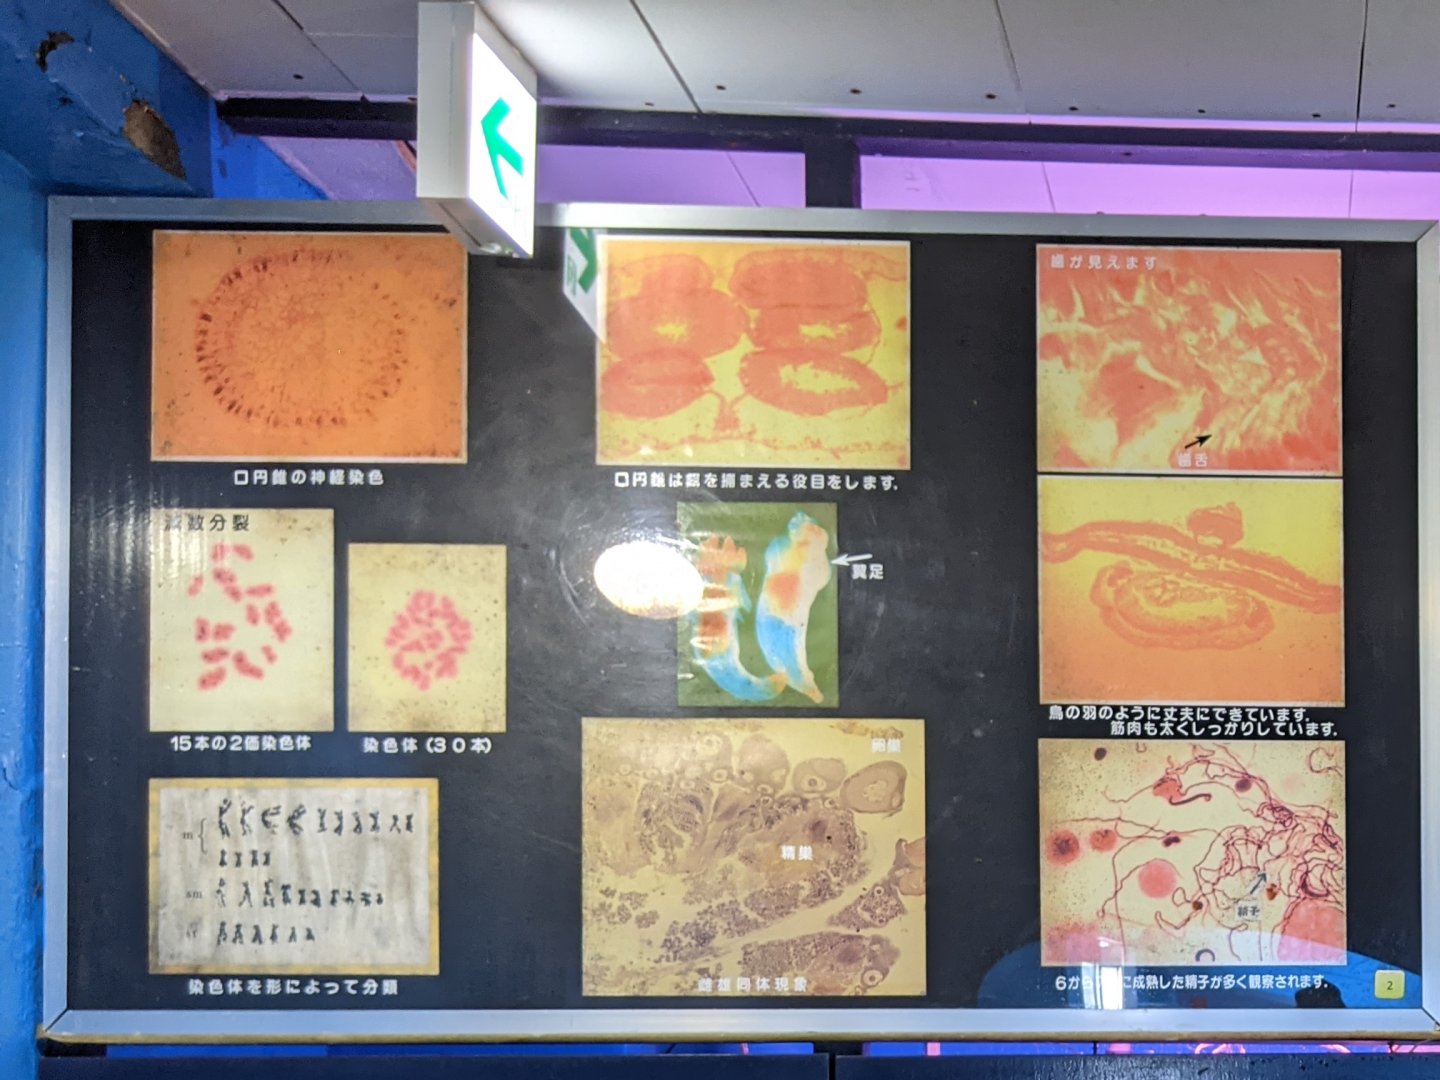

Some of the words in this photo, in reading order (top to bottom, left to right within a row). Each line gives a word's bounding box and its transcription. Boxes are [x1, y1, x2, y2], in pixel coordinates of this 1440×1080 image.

[1050, 254, 1158, 270] 歯が見えます
[188, 979, 399, 996] 染色体を形によって分類
[1386, 981, 1393, 991] 2
